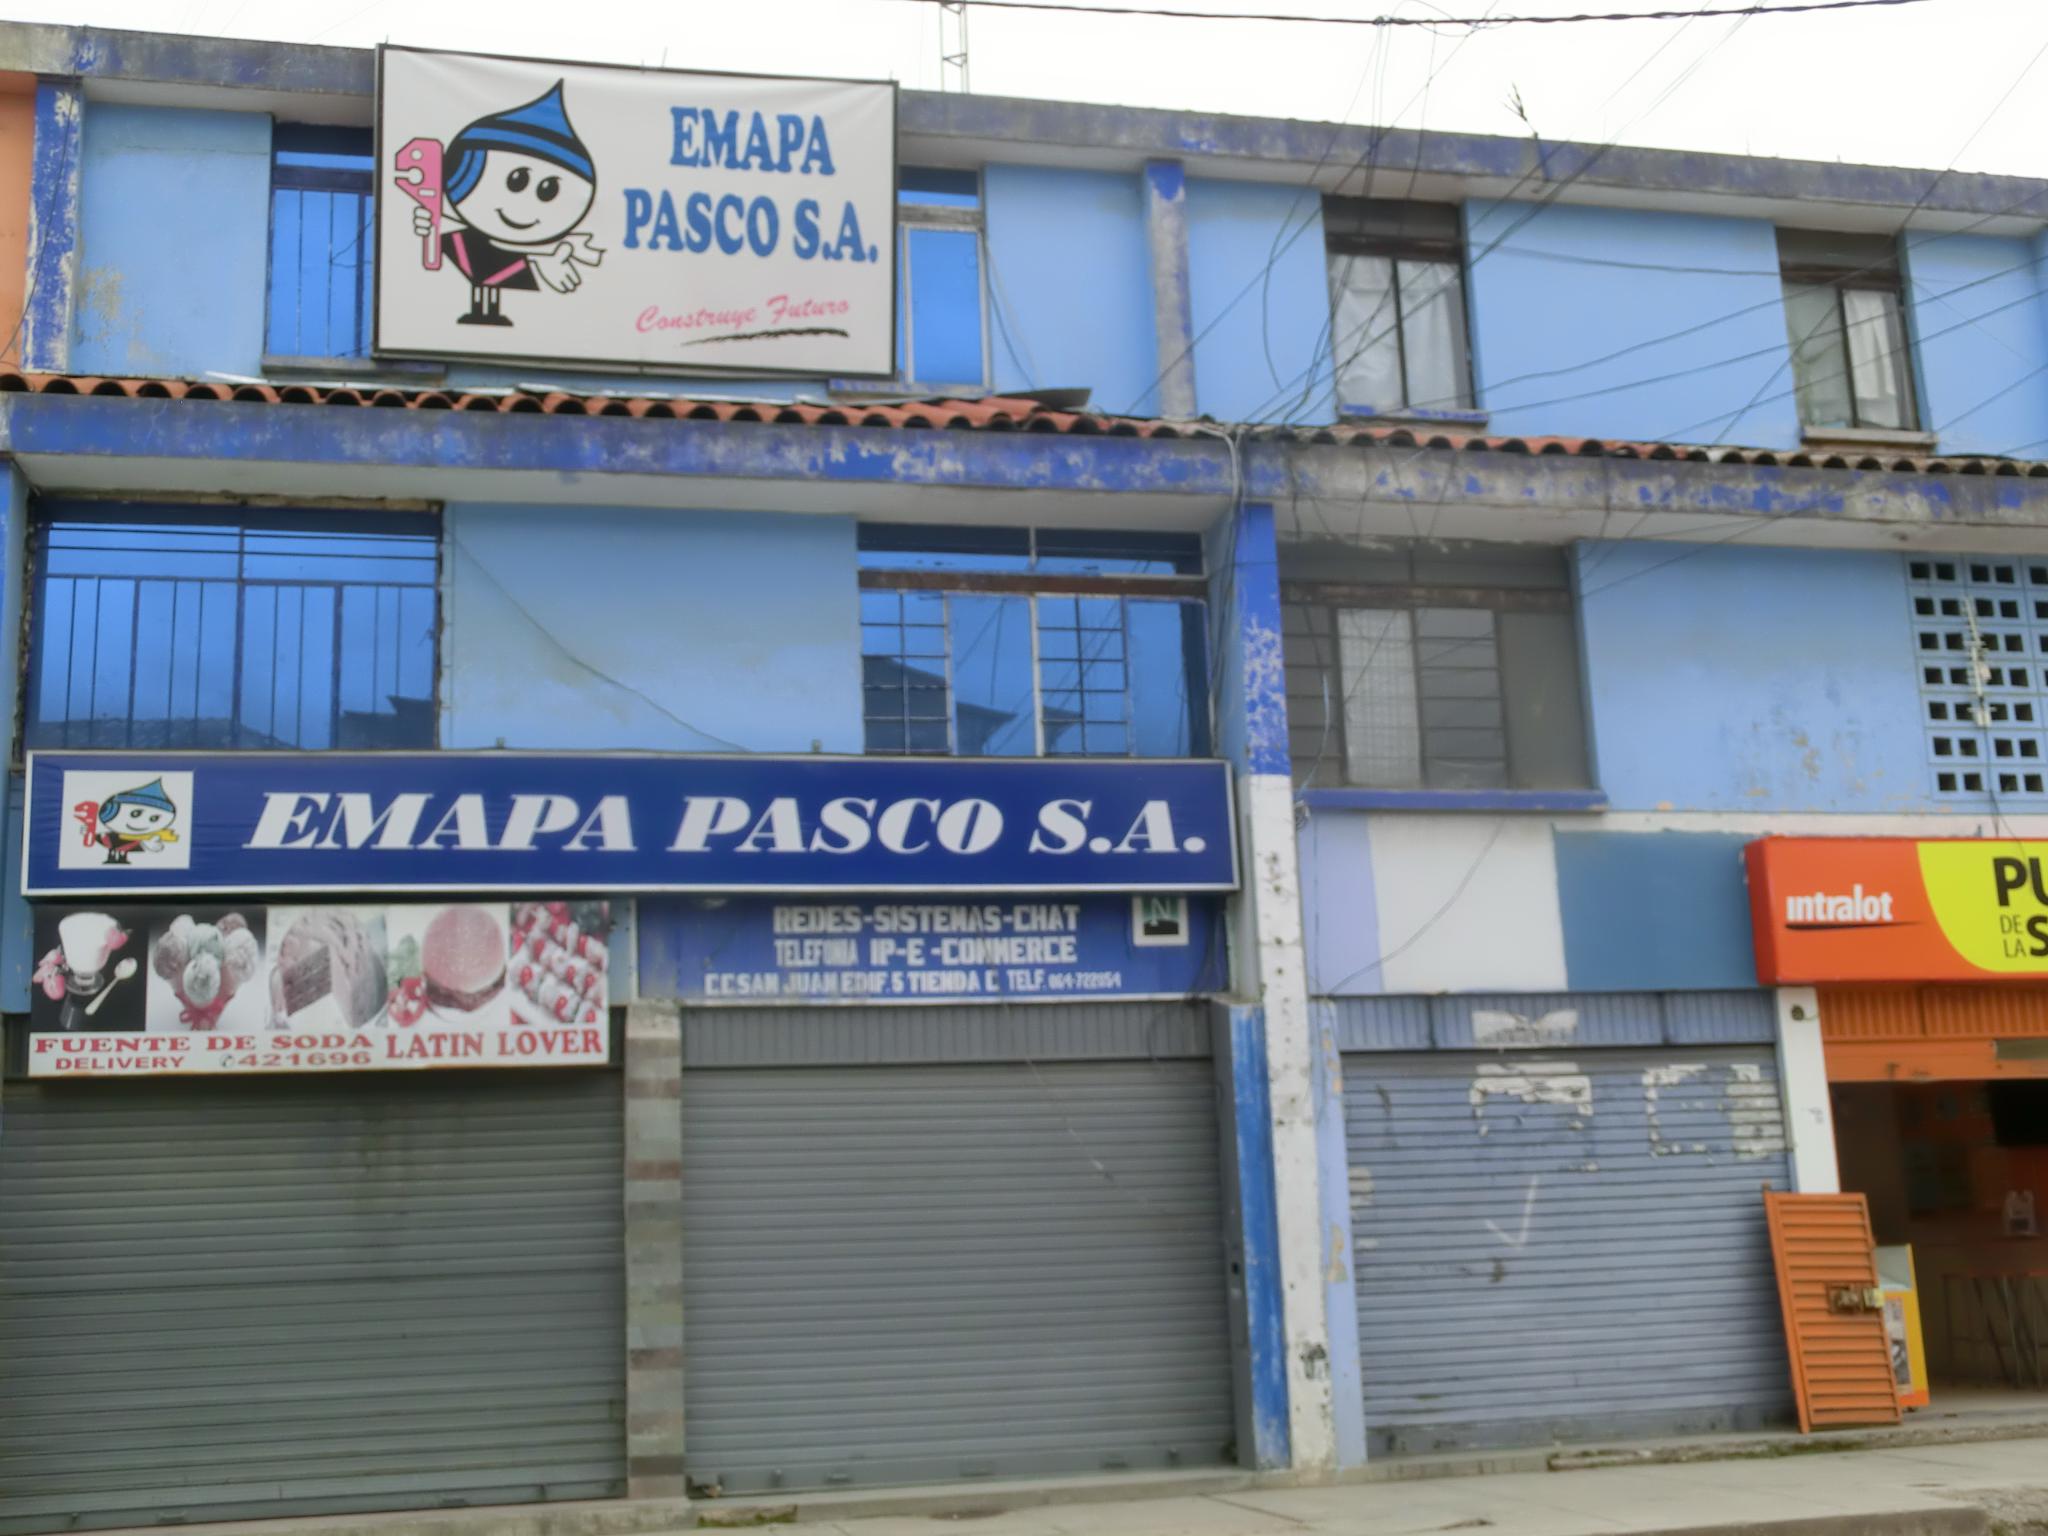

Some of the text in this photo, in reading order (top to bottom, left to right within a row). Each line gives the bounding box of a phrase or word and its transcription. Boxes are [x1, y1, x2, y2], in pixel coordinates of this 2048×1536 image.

[670, 106, 836, 176] EMAPA
[623, 188, 878, 264] PASCO S.A.
[635, 294, 850, 333] Construye Futuro
[242, 792, 1206, 855] EMAPA PASCO S.A.
[2000, 914, 2023, 934] DE
[2003, 938, 2027, 958] LA
[907, 969, 980, 993] TIENDA
[34, 1028, 603, 1060] FUENTE DE SODA LATIN LOVER
[54, 1051, 372, 1071] DELIVERY 421696
